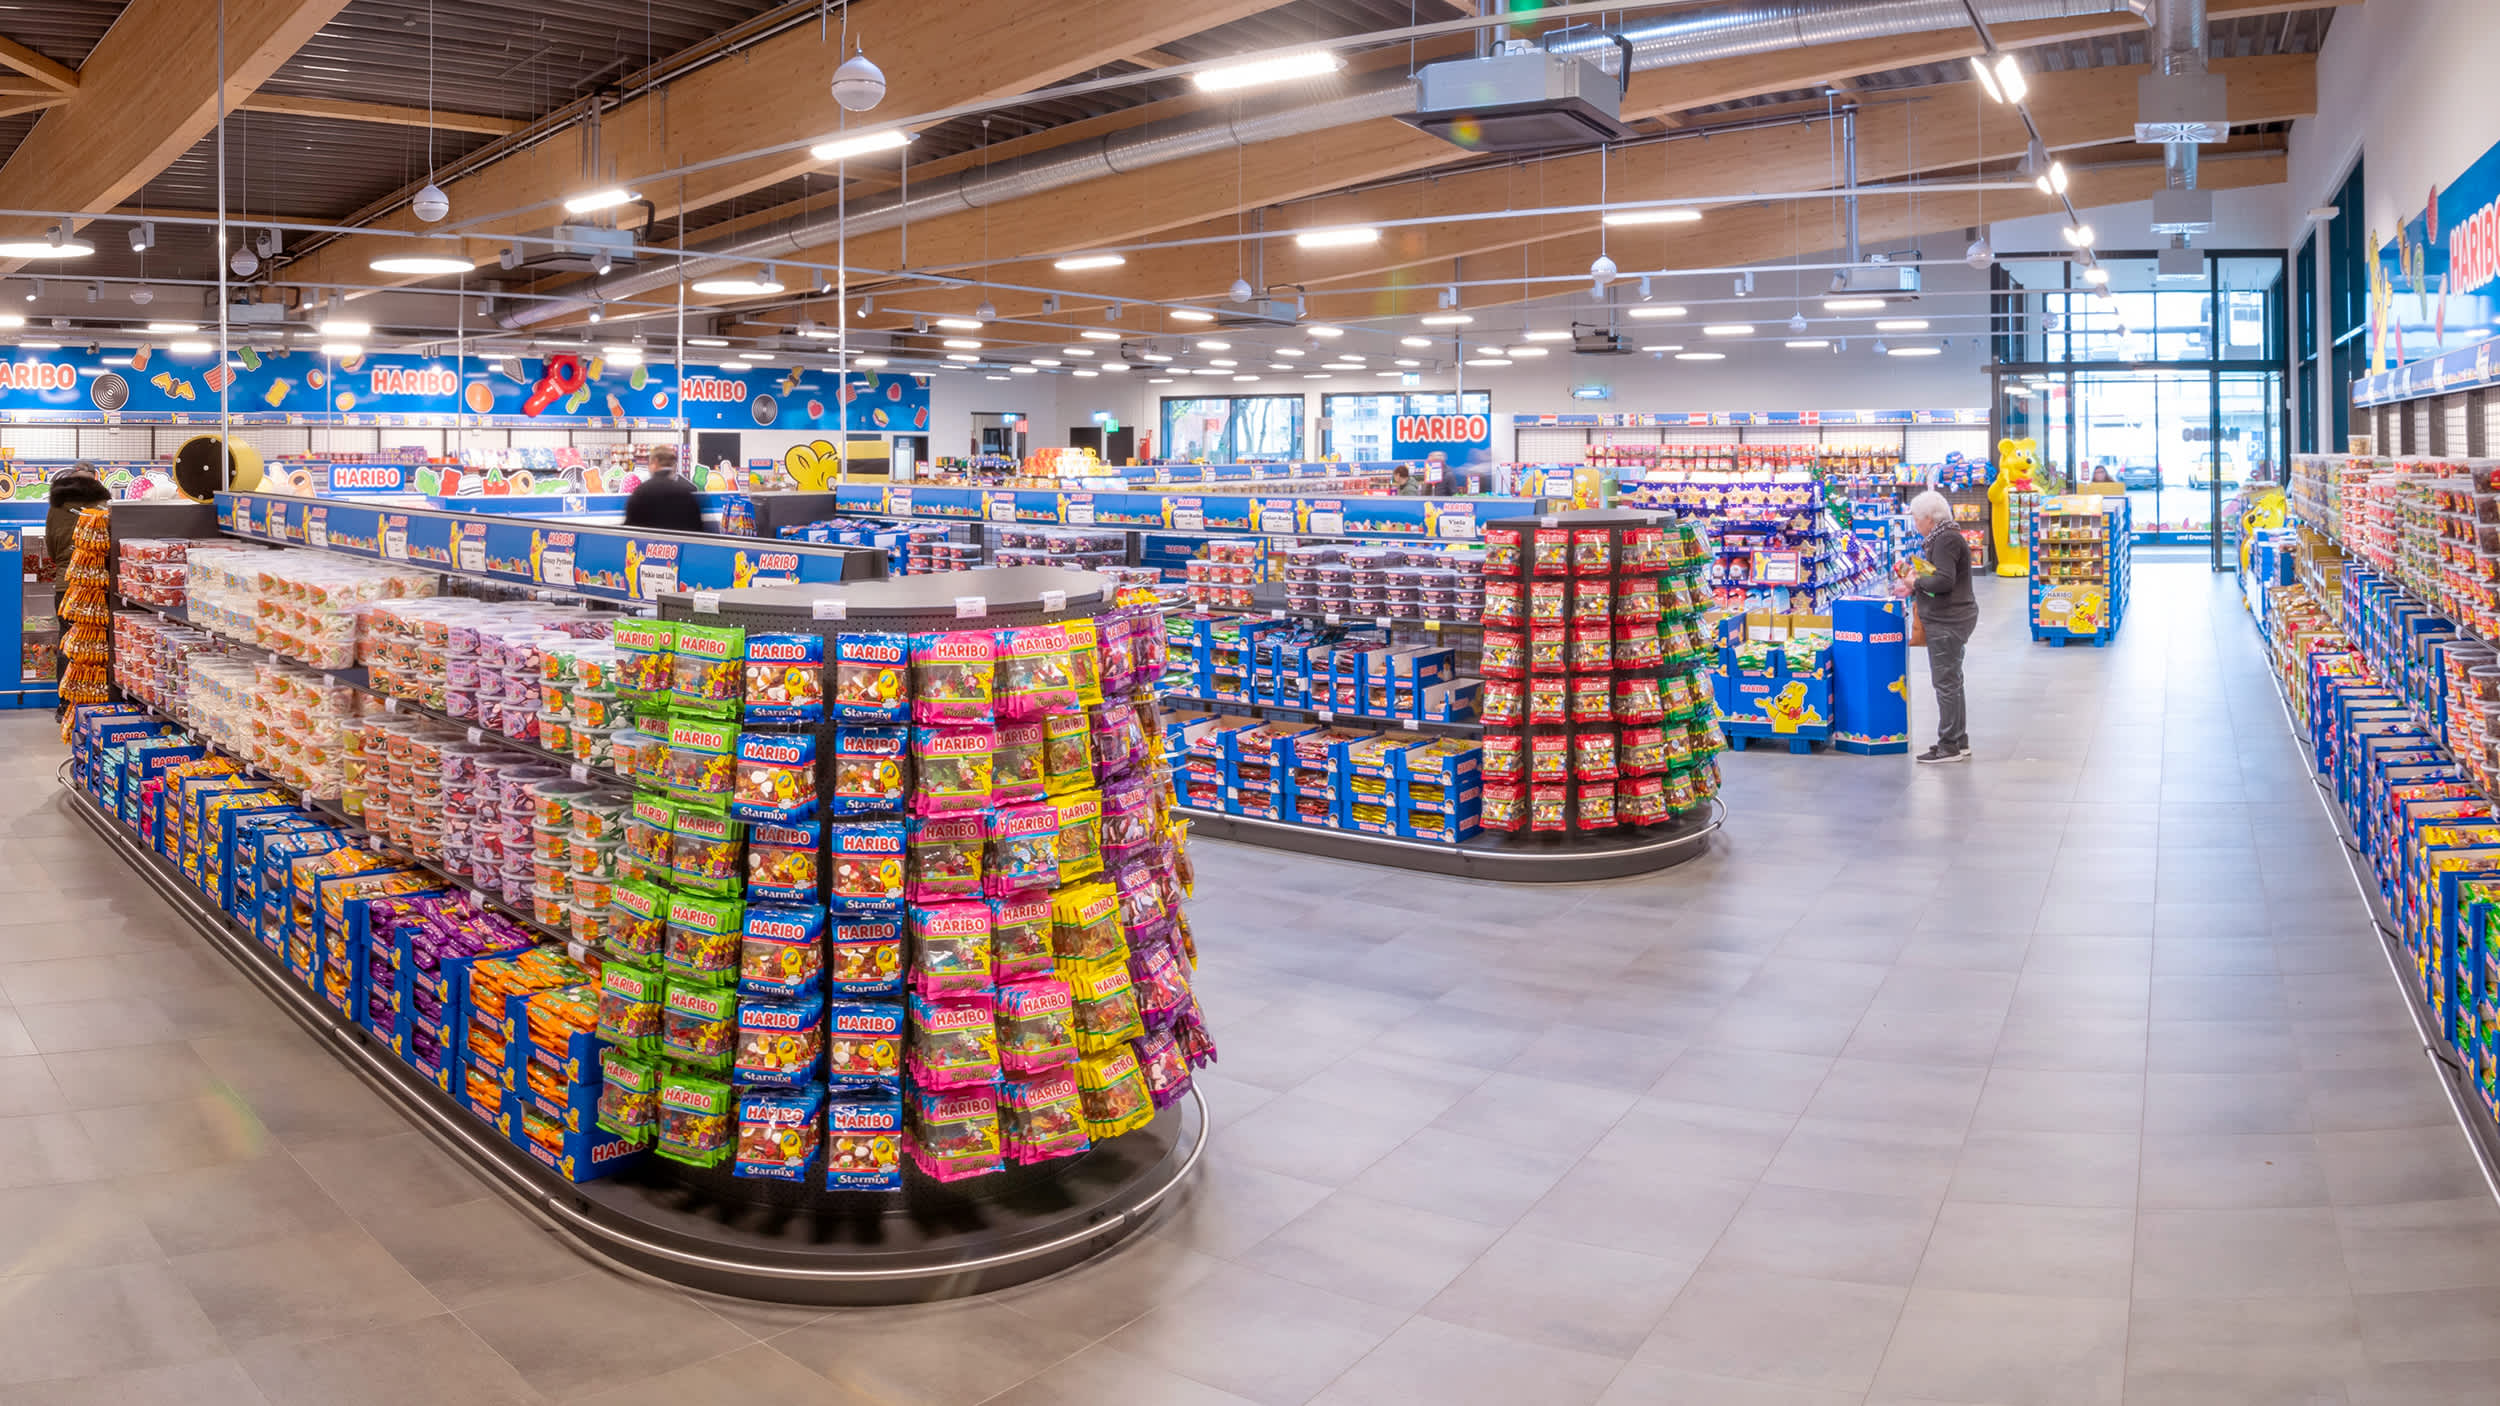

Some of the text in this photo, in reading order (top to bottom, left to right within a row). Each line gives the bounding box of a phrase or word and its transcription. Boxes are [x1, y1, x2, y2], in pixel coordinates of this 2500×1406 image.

[0, 362, 76, 390] ARIBO
[372, 370, 457, 394] HARIBO
[681, 379, 747, 402] HARIBO
[1397, 416, 1487, 442] HARIBO
[335, 467, 398, 487] HARIBO
[548, 532, 576, 547] HARIBO
[646, 544, 679, 560] HARIBO
[759, 553, 799, 570] HARIBO
[616, 630, 655, 646] HARIBO
[680, 634, 726, 655] HARIBO
[1016, 637, 1063, 652] HARIBO
[1069, 630, 1093, 646] RIBO
[1835, 630, 1863, 642] HARIBO
[1869, 632, 1903, 643] HARIBO
[750, 643, 807, 660] HARIBO
[842, 644, 901, 662] HARIBO
[937, 643, 988, 659] HARIBO
[1740, 684, 1769, 693] HARIBO
[755, 707, 800, 719] Starmix
[843, 707, 891, 720] Starmix
[1051, 717, 1086, 733] HARIBO
[673, 728, 722, 748] HARIBO
[844, 736, 900, 753] HARIBO
[933, 735, 987, 752] HARIBO
[995, 728, 1040, 745] HARIBO
[745, 745, 800, 762] HARIBO
[740, 805, 787, 821] Starmix
[847, 799, 893, 810] Starmix
[1060, 801, 1097, 822] HARIBO
[636, 802, 668, 825] HARIBO
[678, 814, 725, 835] HARIBO
[924, 822, 978, 839] HARIBO
[1008, 814, 1055, 832] HARIBO
[755, 828, 810, 845] HARIBO
[843, 836, 899, 852] HARIBO
[615, 887, 651, 913] HARIBO
[757, 888, 803, 900] Starmix
[846, 900, 895, 911] Starmix
[1002, 904, 1048, 921] HARIBO
[1083, 896, 1114, 921] HARIBO
[672, 906, 717, 928] HARIBO
[932, 917, 985, 934] HARIBO
[750, 921, 805, 940] HARIBO
[837, 922, 894, 940] HARIBO
[605, 973, 643, 995] HARIBO
[748, 982, 793, 996] Starmix
[844, 983, 892, 994] Starmix
[1094, 973, 1129, 994] HARIBO
[670, 993, 718, 1014] HARIBO
[1023, 993, 1067, 1013] HARIBO
[743, 1010, 799, 1028] HARIBO
[837, 1015, 896, 1032] HARIBO
[934, 1009, 986, 1027] HARIBO
[606, 1060, 640, 1086] HARIBO
[742, 1071, 791, 1084] Starmix
[1101, 1057, 1134, 1081] HARIBO
[663, 1087, 712, 1109] HARIBO
[1029, 1080, 1073, 1102] HARIBO
[747, 1106, 803, 1122] HARIBO
[939, 1098, 992, 1117] HARIBO
[835, 1113, 894, 1129] HARIBO
[745, 1165, 794, 1178] Starmix
[838, 1173, 889, 1185] Starmix
